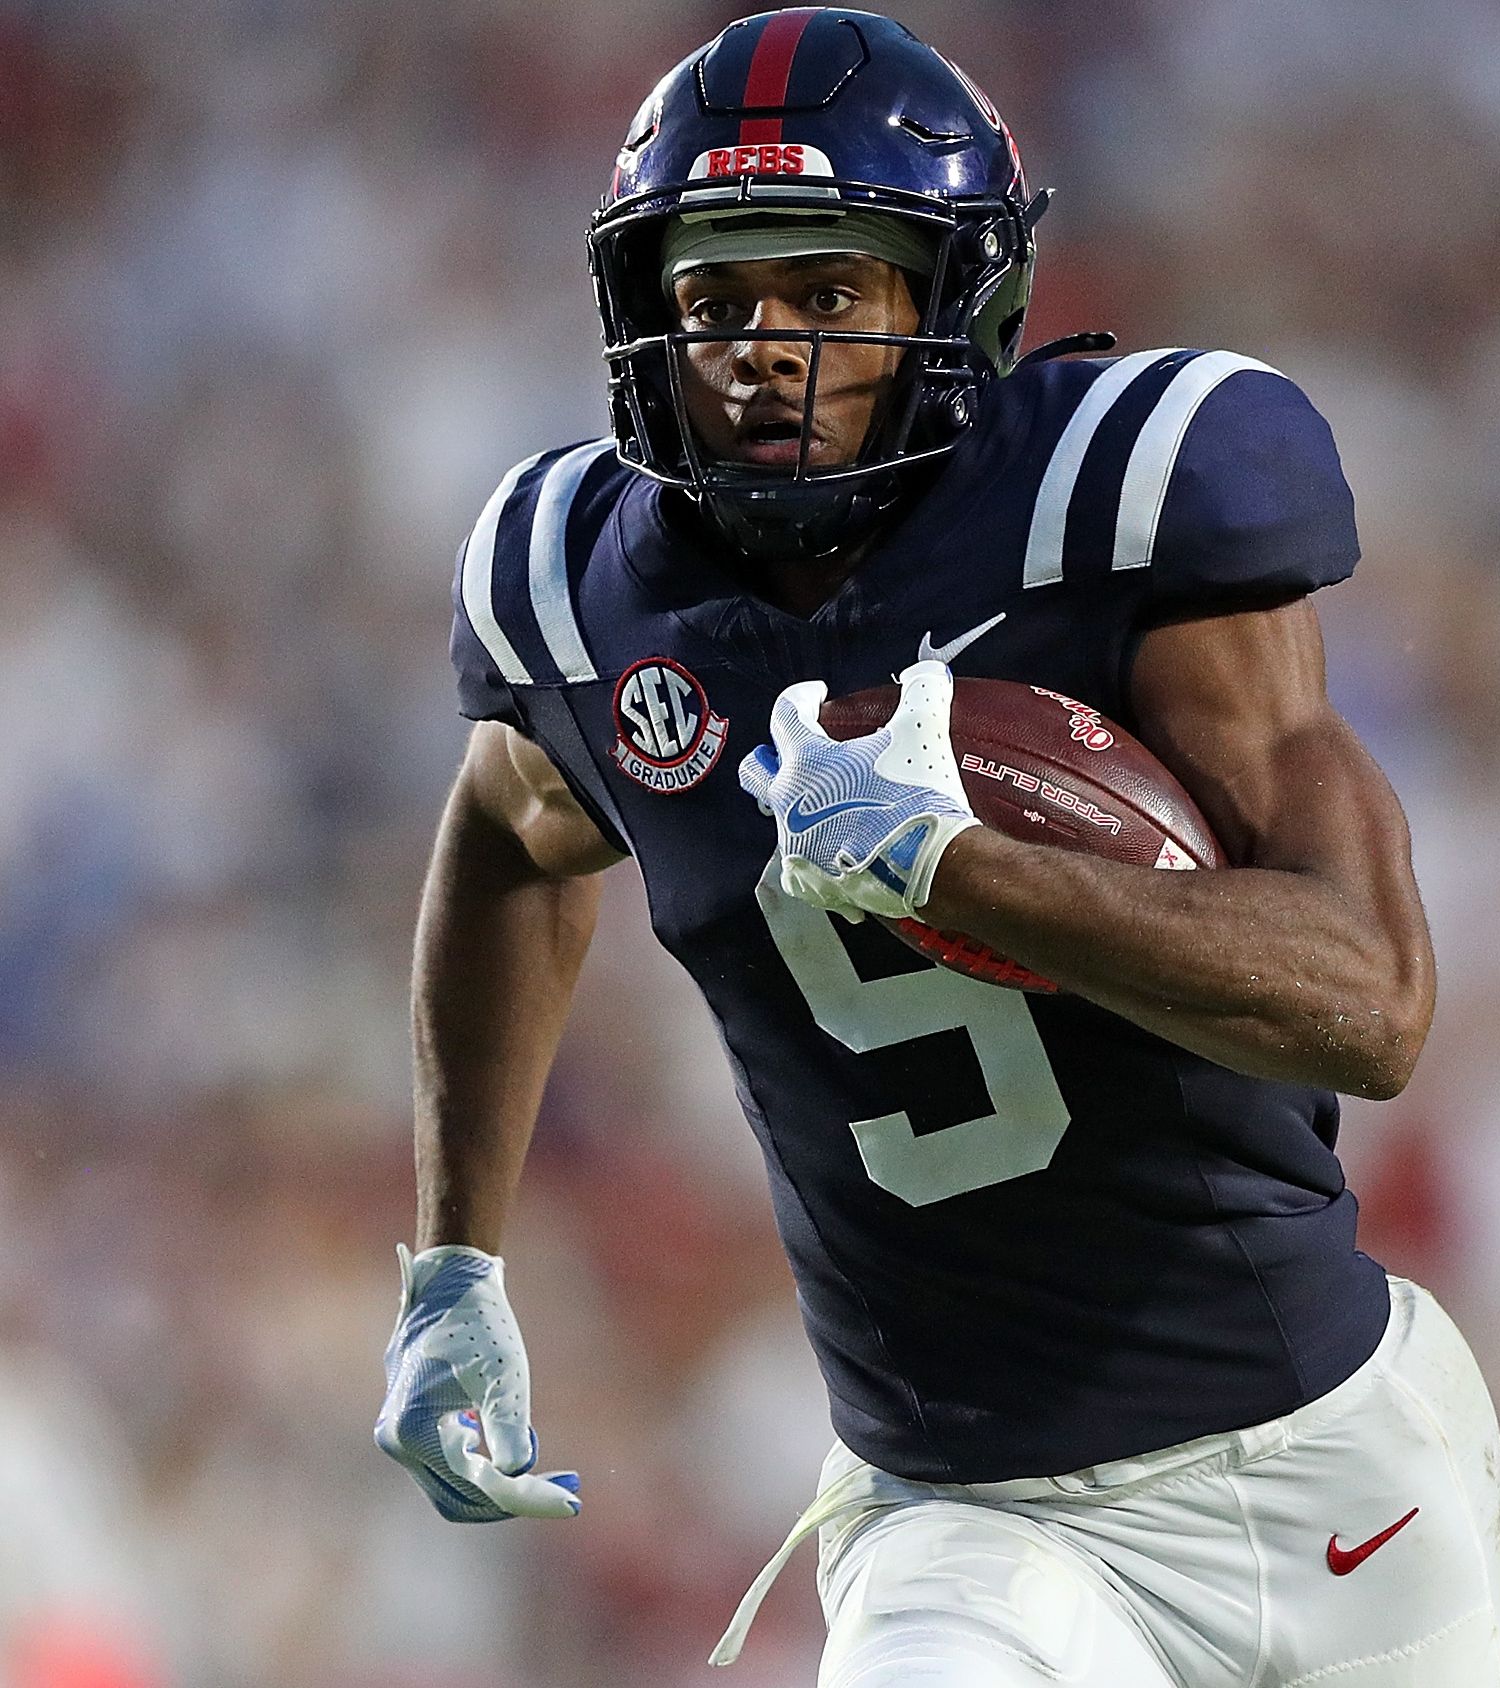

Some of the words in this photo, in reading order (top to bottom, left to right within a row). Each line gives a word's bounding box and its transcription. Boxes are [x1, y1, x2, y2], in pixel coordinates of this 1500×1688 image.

[707, 146, 804, 177] REBS
[620, 667, 698, 758] SEC
[1069, 714, 1114, 751] Ole
[629, 742, 715, 789] GRADUATE
[961, 753, 1040, 792] ELITE
[1041, 782, 1122, 836] VAPOR
